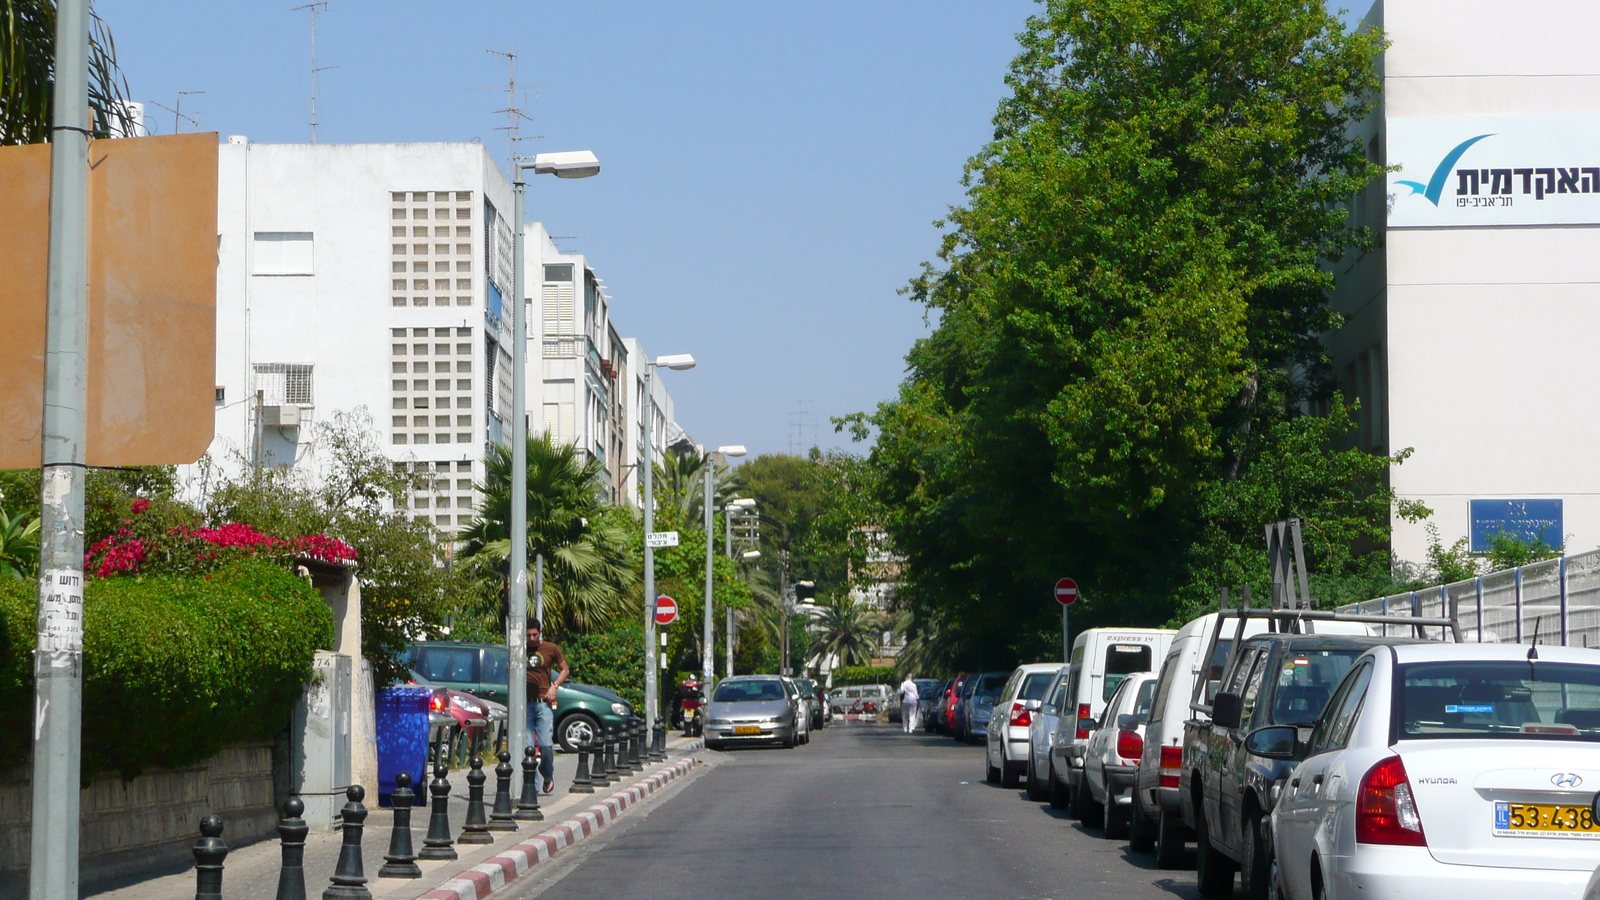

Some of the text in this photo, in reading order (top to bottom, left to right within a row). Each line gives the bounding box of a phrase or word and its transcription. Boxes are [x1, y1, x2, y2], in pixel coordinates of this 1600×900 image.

[1456, 167, 1600, 200] האקדמית
[1106, 635, 1142, 643] express
[1418, 777, 1458, 785] HYUNDAI
[1498, 811, 1507, 822] IL
